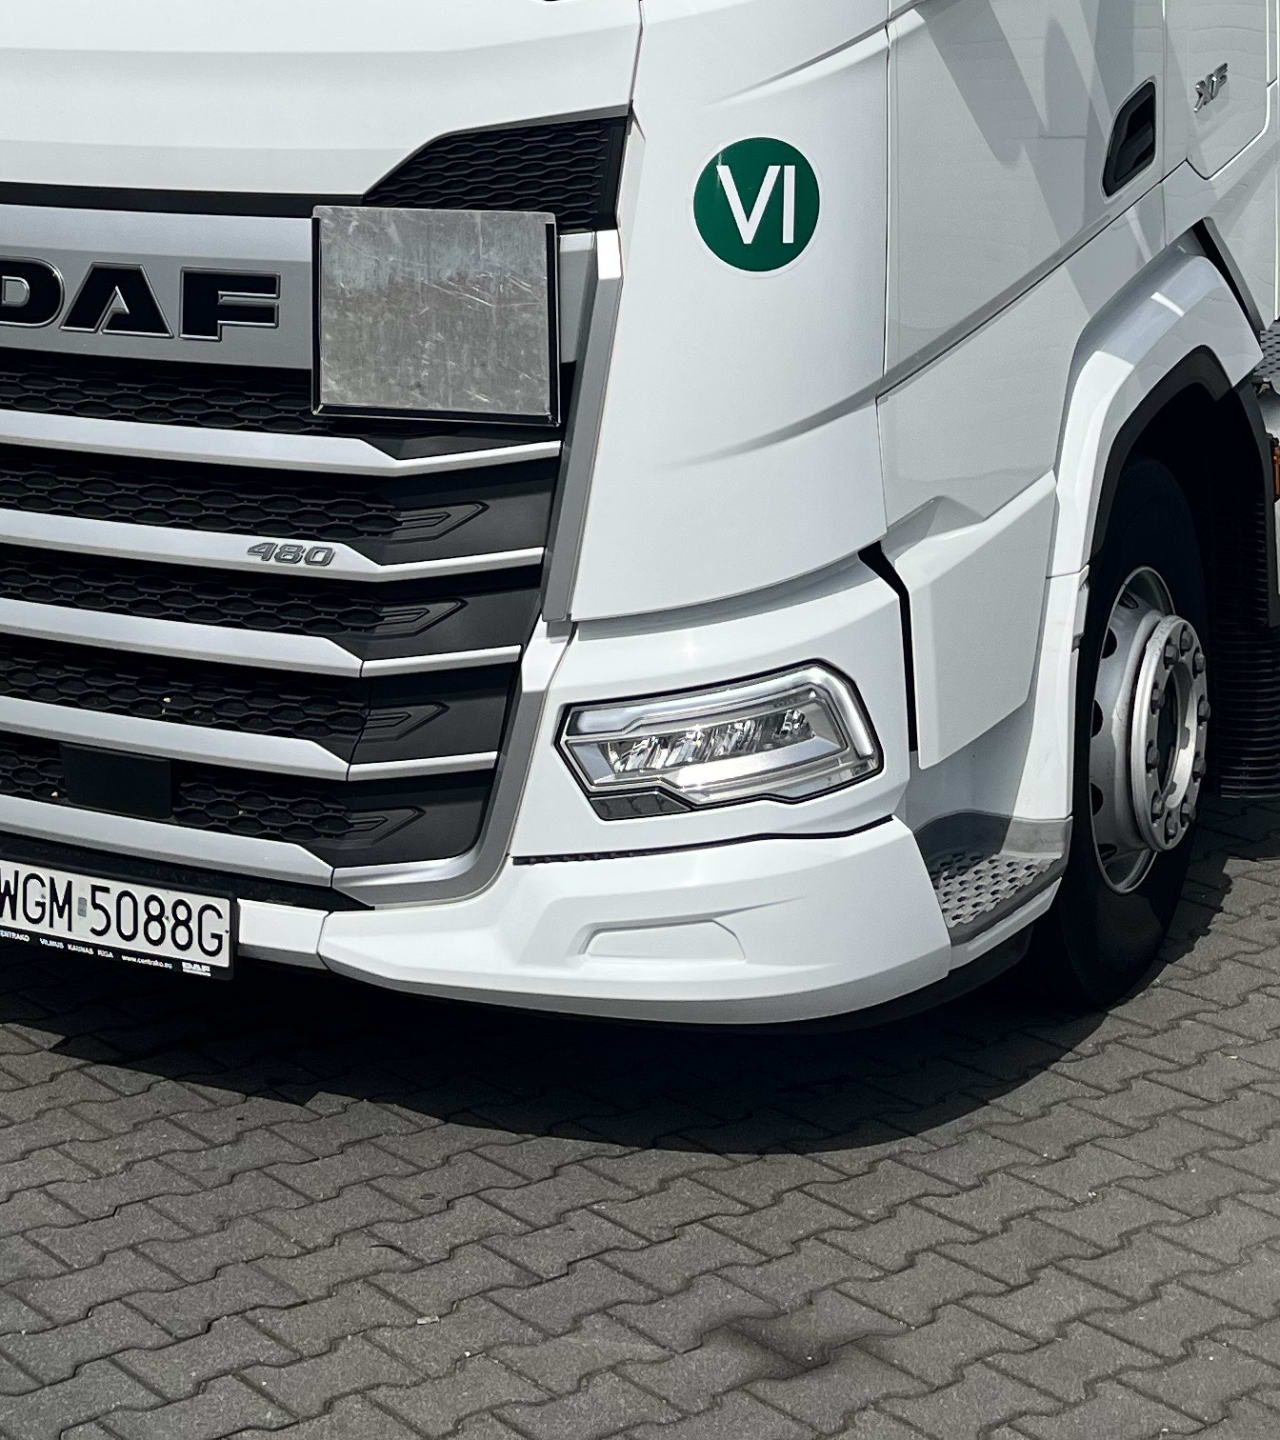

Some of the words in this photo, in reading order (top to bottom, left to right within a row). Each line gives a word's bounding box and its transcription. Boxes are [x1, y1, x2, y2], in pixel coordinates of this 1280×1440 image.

[716, 165, 796, 245] VI
[247, 542, 336, 567] 480
[89, 883, 224, 958] 5088G
